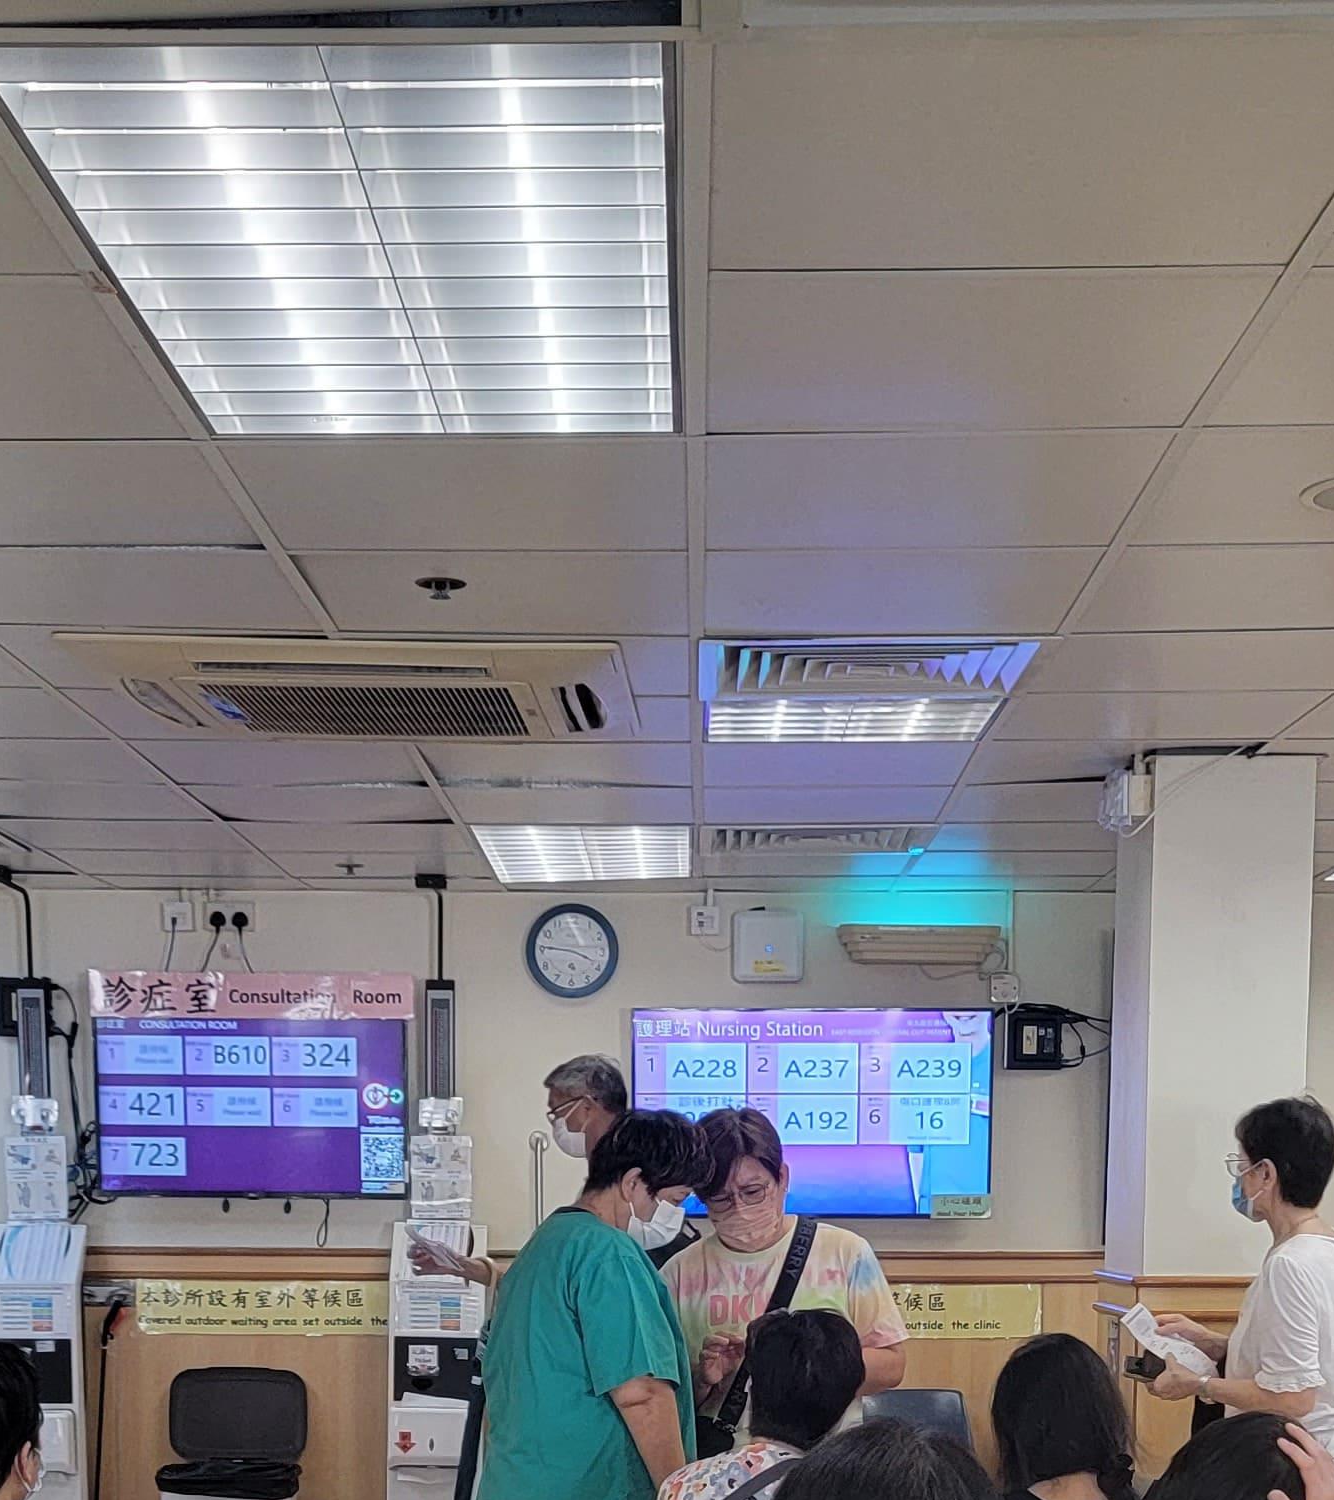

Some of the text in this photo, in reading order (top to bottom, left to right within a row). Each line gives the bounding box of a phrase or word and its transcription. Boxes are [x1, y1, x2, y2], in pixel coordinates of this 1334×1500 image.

[101, 976, 217, 1015] 診症室
[352, 988, 403, 1005] Room
[636, 1019, 824, 1041] 護理站 Nursing Station
[213, 1044, 267, 1065] B610
[281, 1049, 291, 1063] 3
[302, 1042, 352, 1068] 324
[646, 1057, 655, 1073] 1
[671, 1059, 737, 1079] A228
[756, 1057, 769, 1073] 2
[784, 1059, 850, 1079] A237
[869, 1057, 882, 1073] 3
[896, 1059, 962, 1078] A239
[128, 1092, 176, 1117] 421
[783, 1111, 850, 1130] A192
[869, 1109, 882, 1125] 6
[915, 1111, 944, 1130] 16
[130, 1142, 180, 1167] 723
[142, 1288, 364, 1309] 本診所設有室外等候區
[184, 1315, 227, 1326] outdoor
[230, 1316, 268, 1328] waiting
[273, 1318, 298, 1326] area
[302, 1316, 320, 1326] set
[324, 1315, 364, 1326] outside
[370, 1315, 388, 1326] the
[905, 1319, 1002, 1331] outside the clinic
